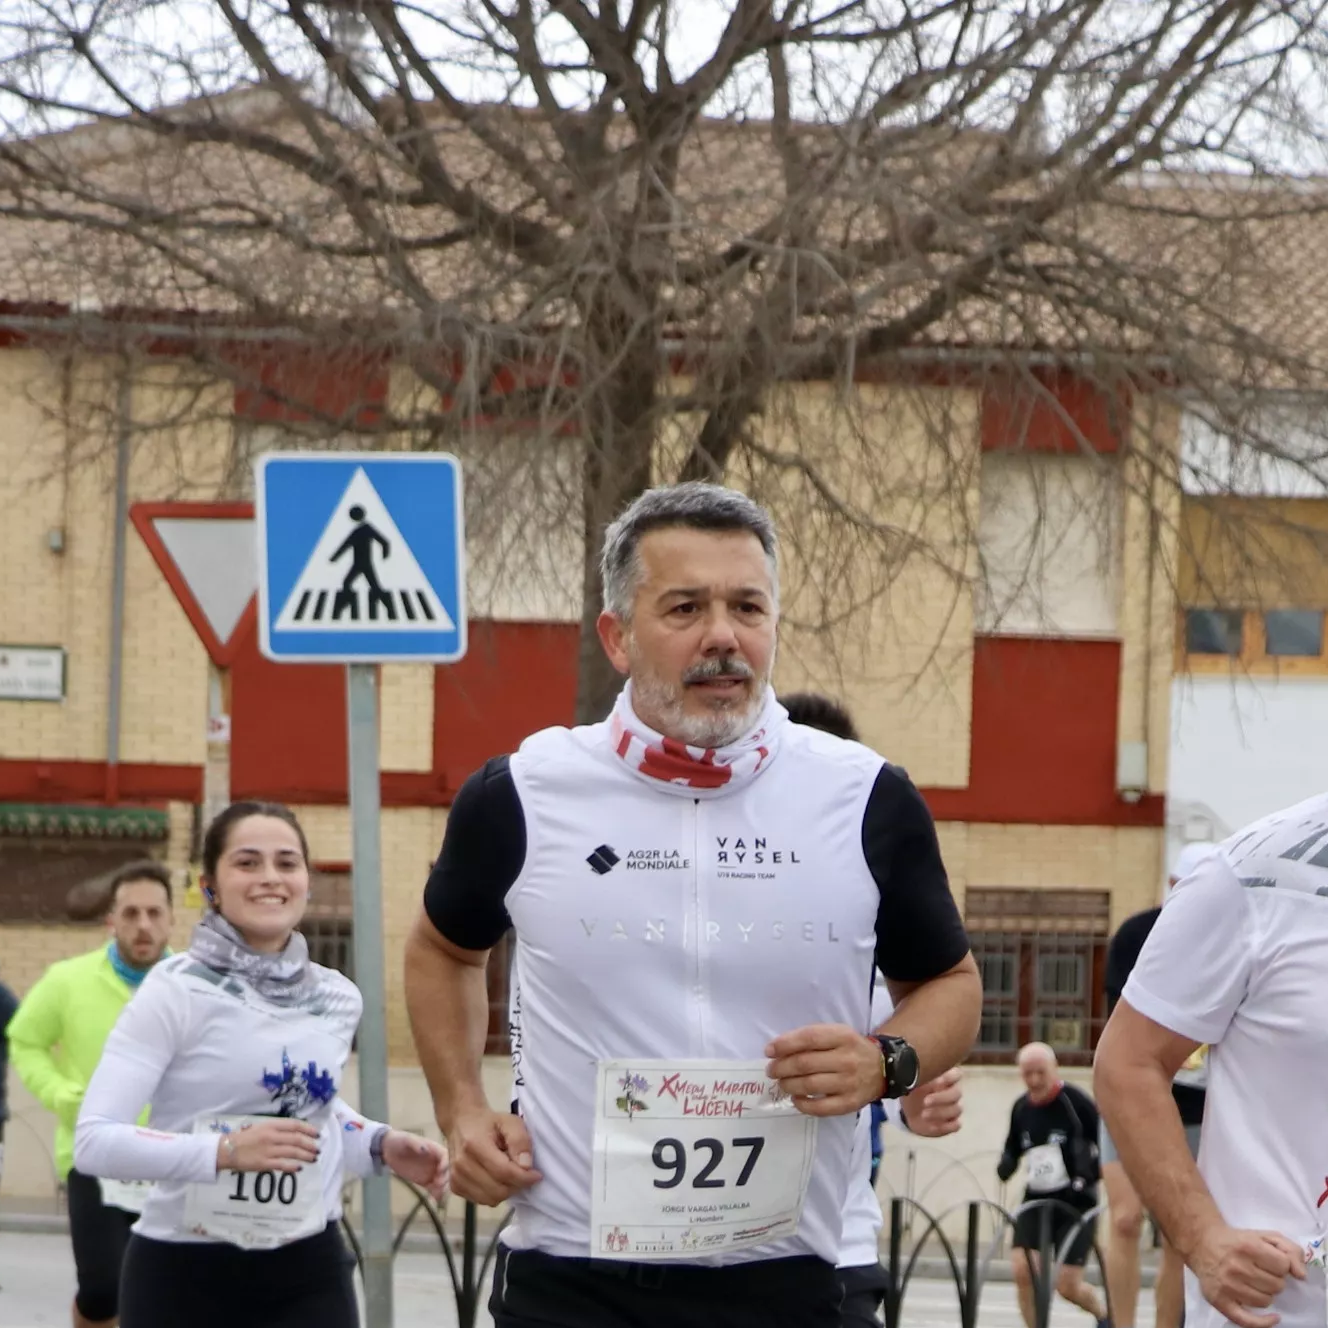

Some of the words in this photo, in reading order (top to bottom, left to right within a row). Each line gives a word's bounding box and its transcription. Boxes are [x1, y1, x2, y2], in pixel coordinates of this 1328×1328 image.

[716, 837, 767, 849] VAN
[627, 850, 660, 860] AG2R
[663, 850, 680, 859] LA
[626, 859, 691, 870] MONDIALE
[757, 872, 776, 880] TEAM
[579, 917, 666, 941] VAN
[705, 920, 840, 943] RYSEL
[651, 1136, 765, 1189] 927
[228, 1170, 298, 1205] 100
[687, 1205, 717, 1213] VARGAS
